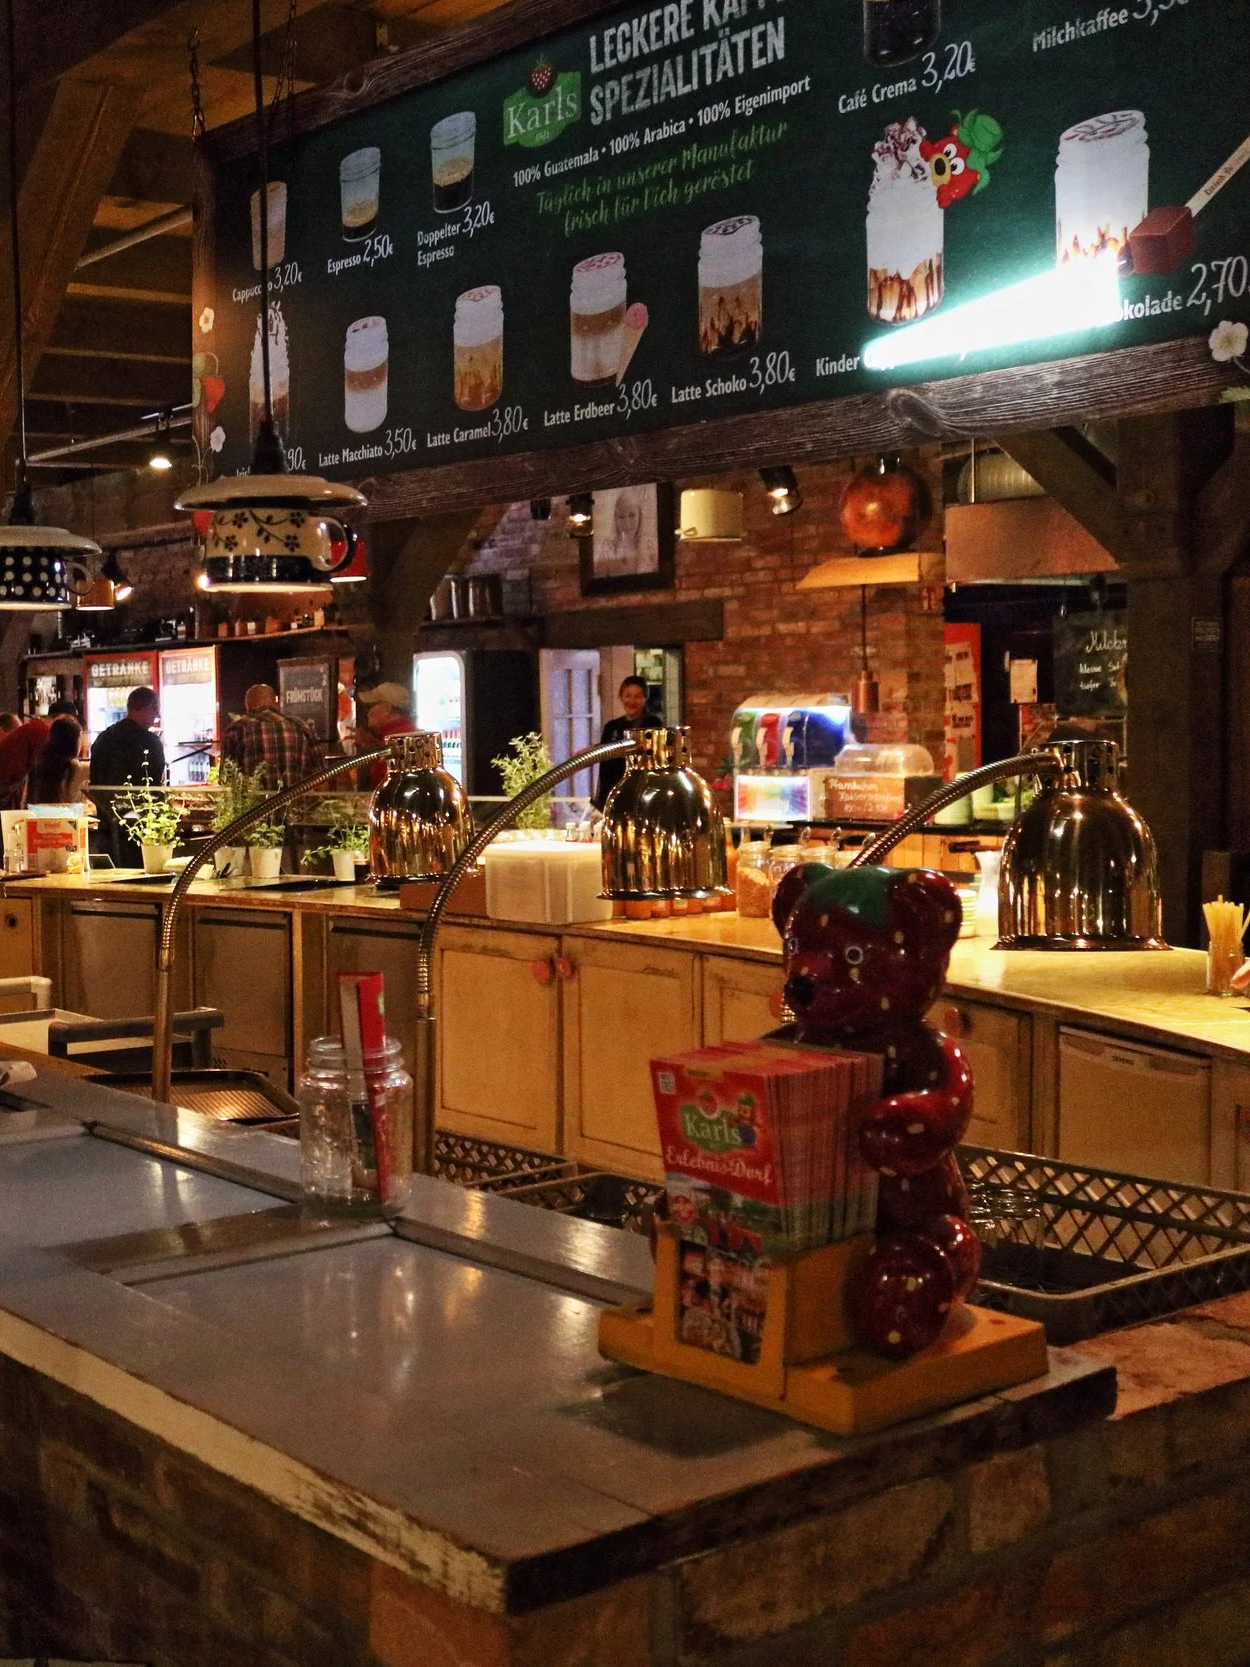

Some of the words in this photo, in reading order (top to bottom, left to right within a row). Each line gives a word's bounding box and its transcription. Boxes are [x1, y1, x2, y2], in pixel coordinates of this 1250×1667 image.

[590, 0, 695, 74] LECKERE
[1032, 8, 1129, 52] Milchkaffee
[590, 16, 785, 126] SPEZIALITÄTEN
[838, 83, 867, 115] Café
[871, 77, 917, 104] Crema
[921, 41, 976, 95] 3,20€
[507, 85, 579, 139] Karls
[513, 164, 541, 188] 100%
[544, 147, 599, 177] Guatemala
[610, 131, 640, 156] 100%
[644, 118, 686, 143] Arabica
[698, 100, 731, 127] 100%
[734, 75, 811, 116] Eigenimport
[537, 178, 591, 215] Täglich
[596, 175, 612, 195] in
[616, 158, 678, 188] unserer
[681, 121, 788, 169] Manufaktur
[565, 205, 609, 237] frisch
[614, 195, 640, 222] für
[684, 159, 754, 204] geröstet
[418, 223, 460, 249] Doppelter
[462, 201, 494, 239] 3,20€
[327, 253, 361, 275] Espresso
[362, 235, 393, 267] 2,50€
[418, 246, 454, 267] Espresso
[232, 281, 273, 304] Cappucco
[274, 262, 303, 292] 3,20€
[671, 385, 701, 404] Latte
[705, 376, 747, 398] Schoko
[749, 351, 796, 395] 3,80€
[816, 353, 861, 377] Kinder
[427, 431, 450, 448] Latte
[453, 422, 491, 443] Caramel
[491, 406, 529, 443] 3,80€
[544, 409, 570, 427] Latte
[574, 401, 615, 422] Erdbeer
[617, 379, 657, 420] 3,80€
[319, 452, 339, 467] Latte
[342, 445, 383, 464] Macchiato
[385, 428, 417, 460] 3,50€
[91, 660, 149, 677] GETRÄNKE
[683, 1114, 742, 1145] Karls
